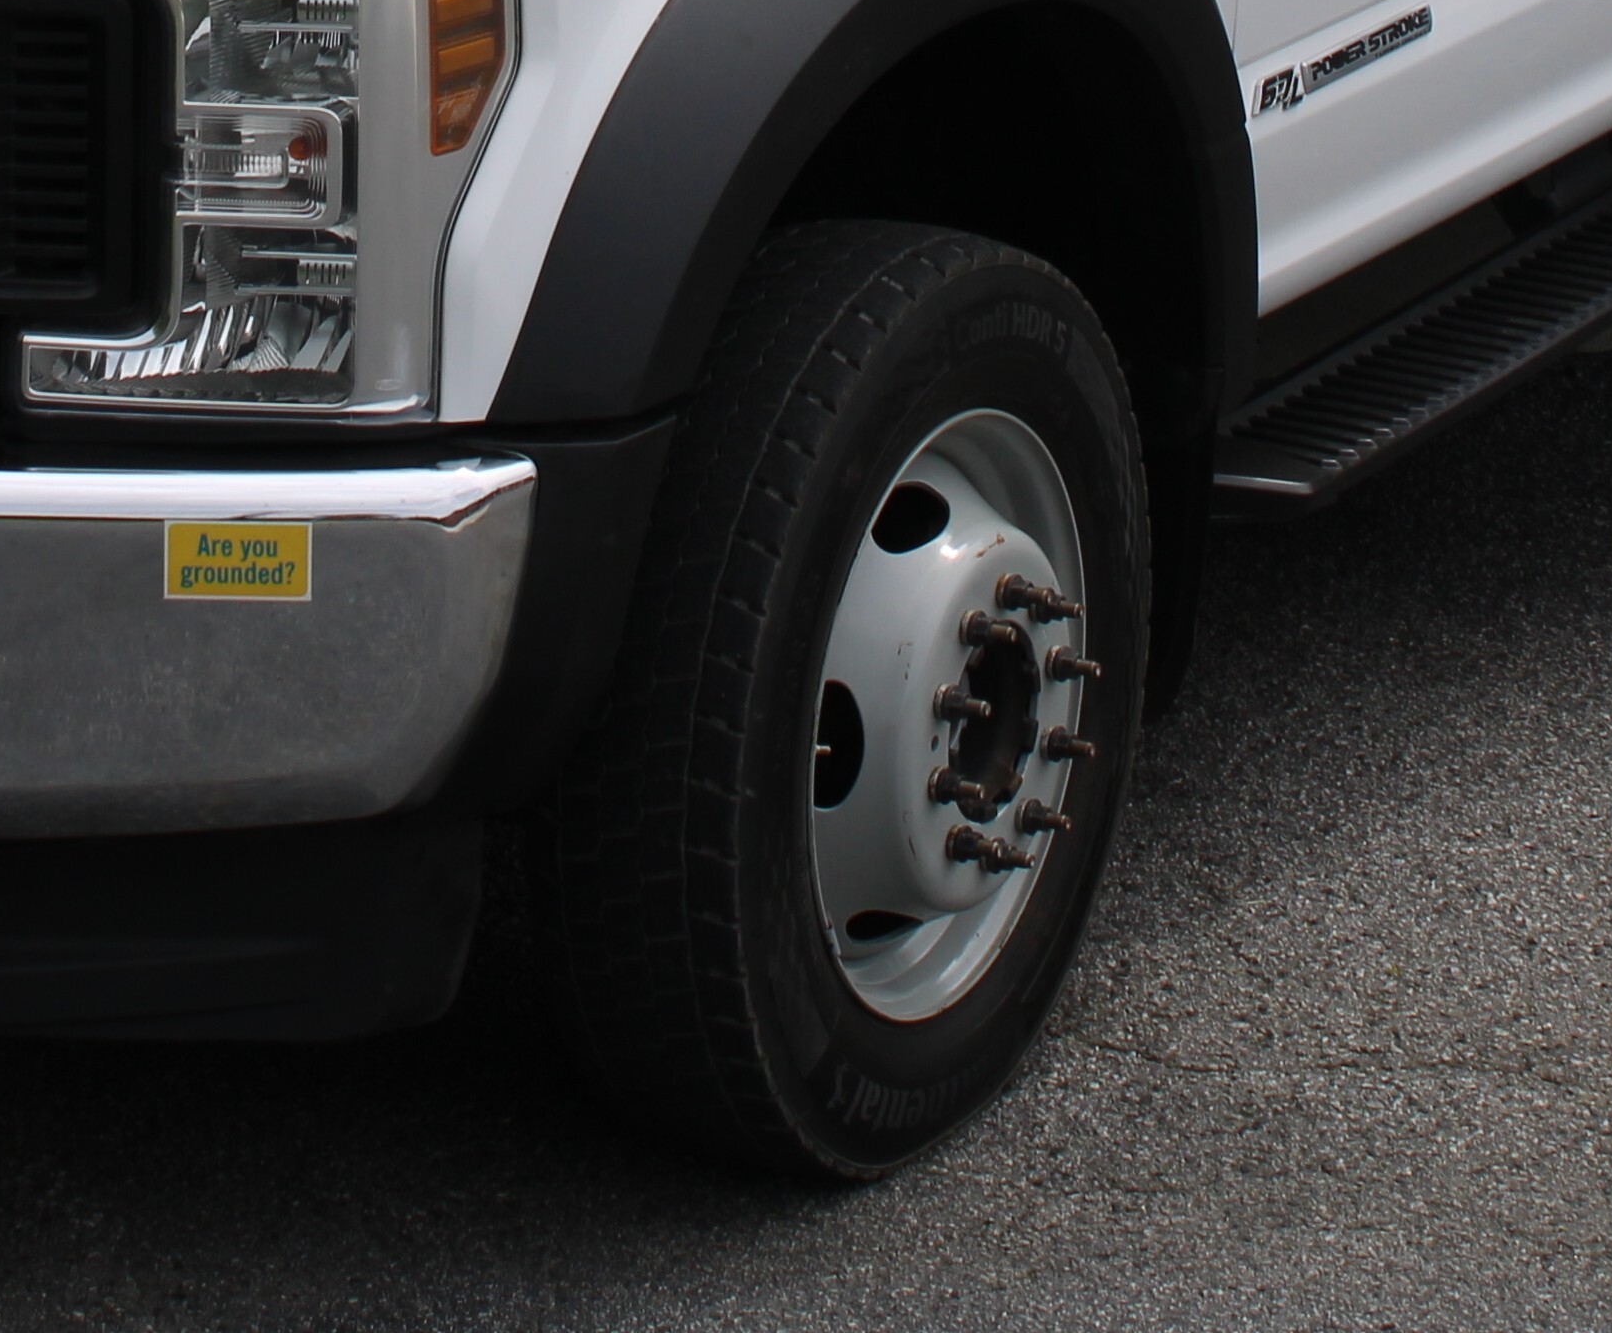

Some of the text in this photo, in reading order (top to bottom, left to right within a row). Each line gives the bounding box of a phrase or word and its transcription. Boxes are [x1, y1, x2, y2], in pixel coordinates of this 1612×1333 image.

[1310, 39, 1366, 81] POWER
[1367, 7, 1430, 53] STROKE
[955, 301, 1067, 355] Conti HDR 5
[197, 533, 278, 562] Are you
[180, 561, 296, 588] grounded?
